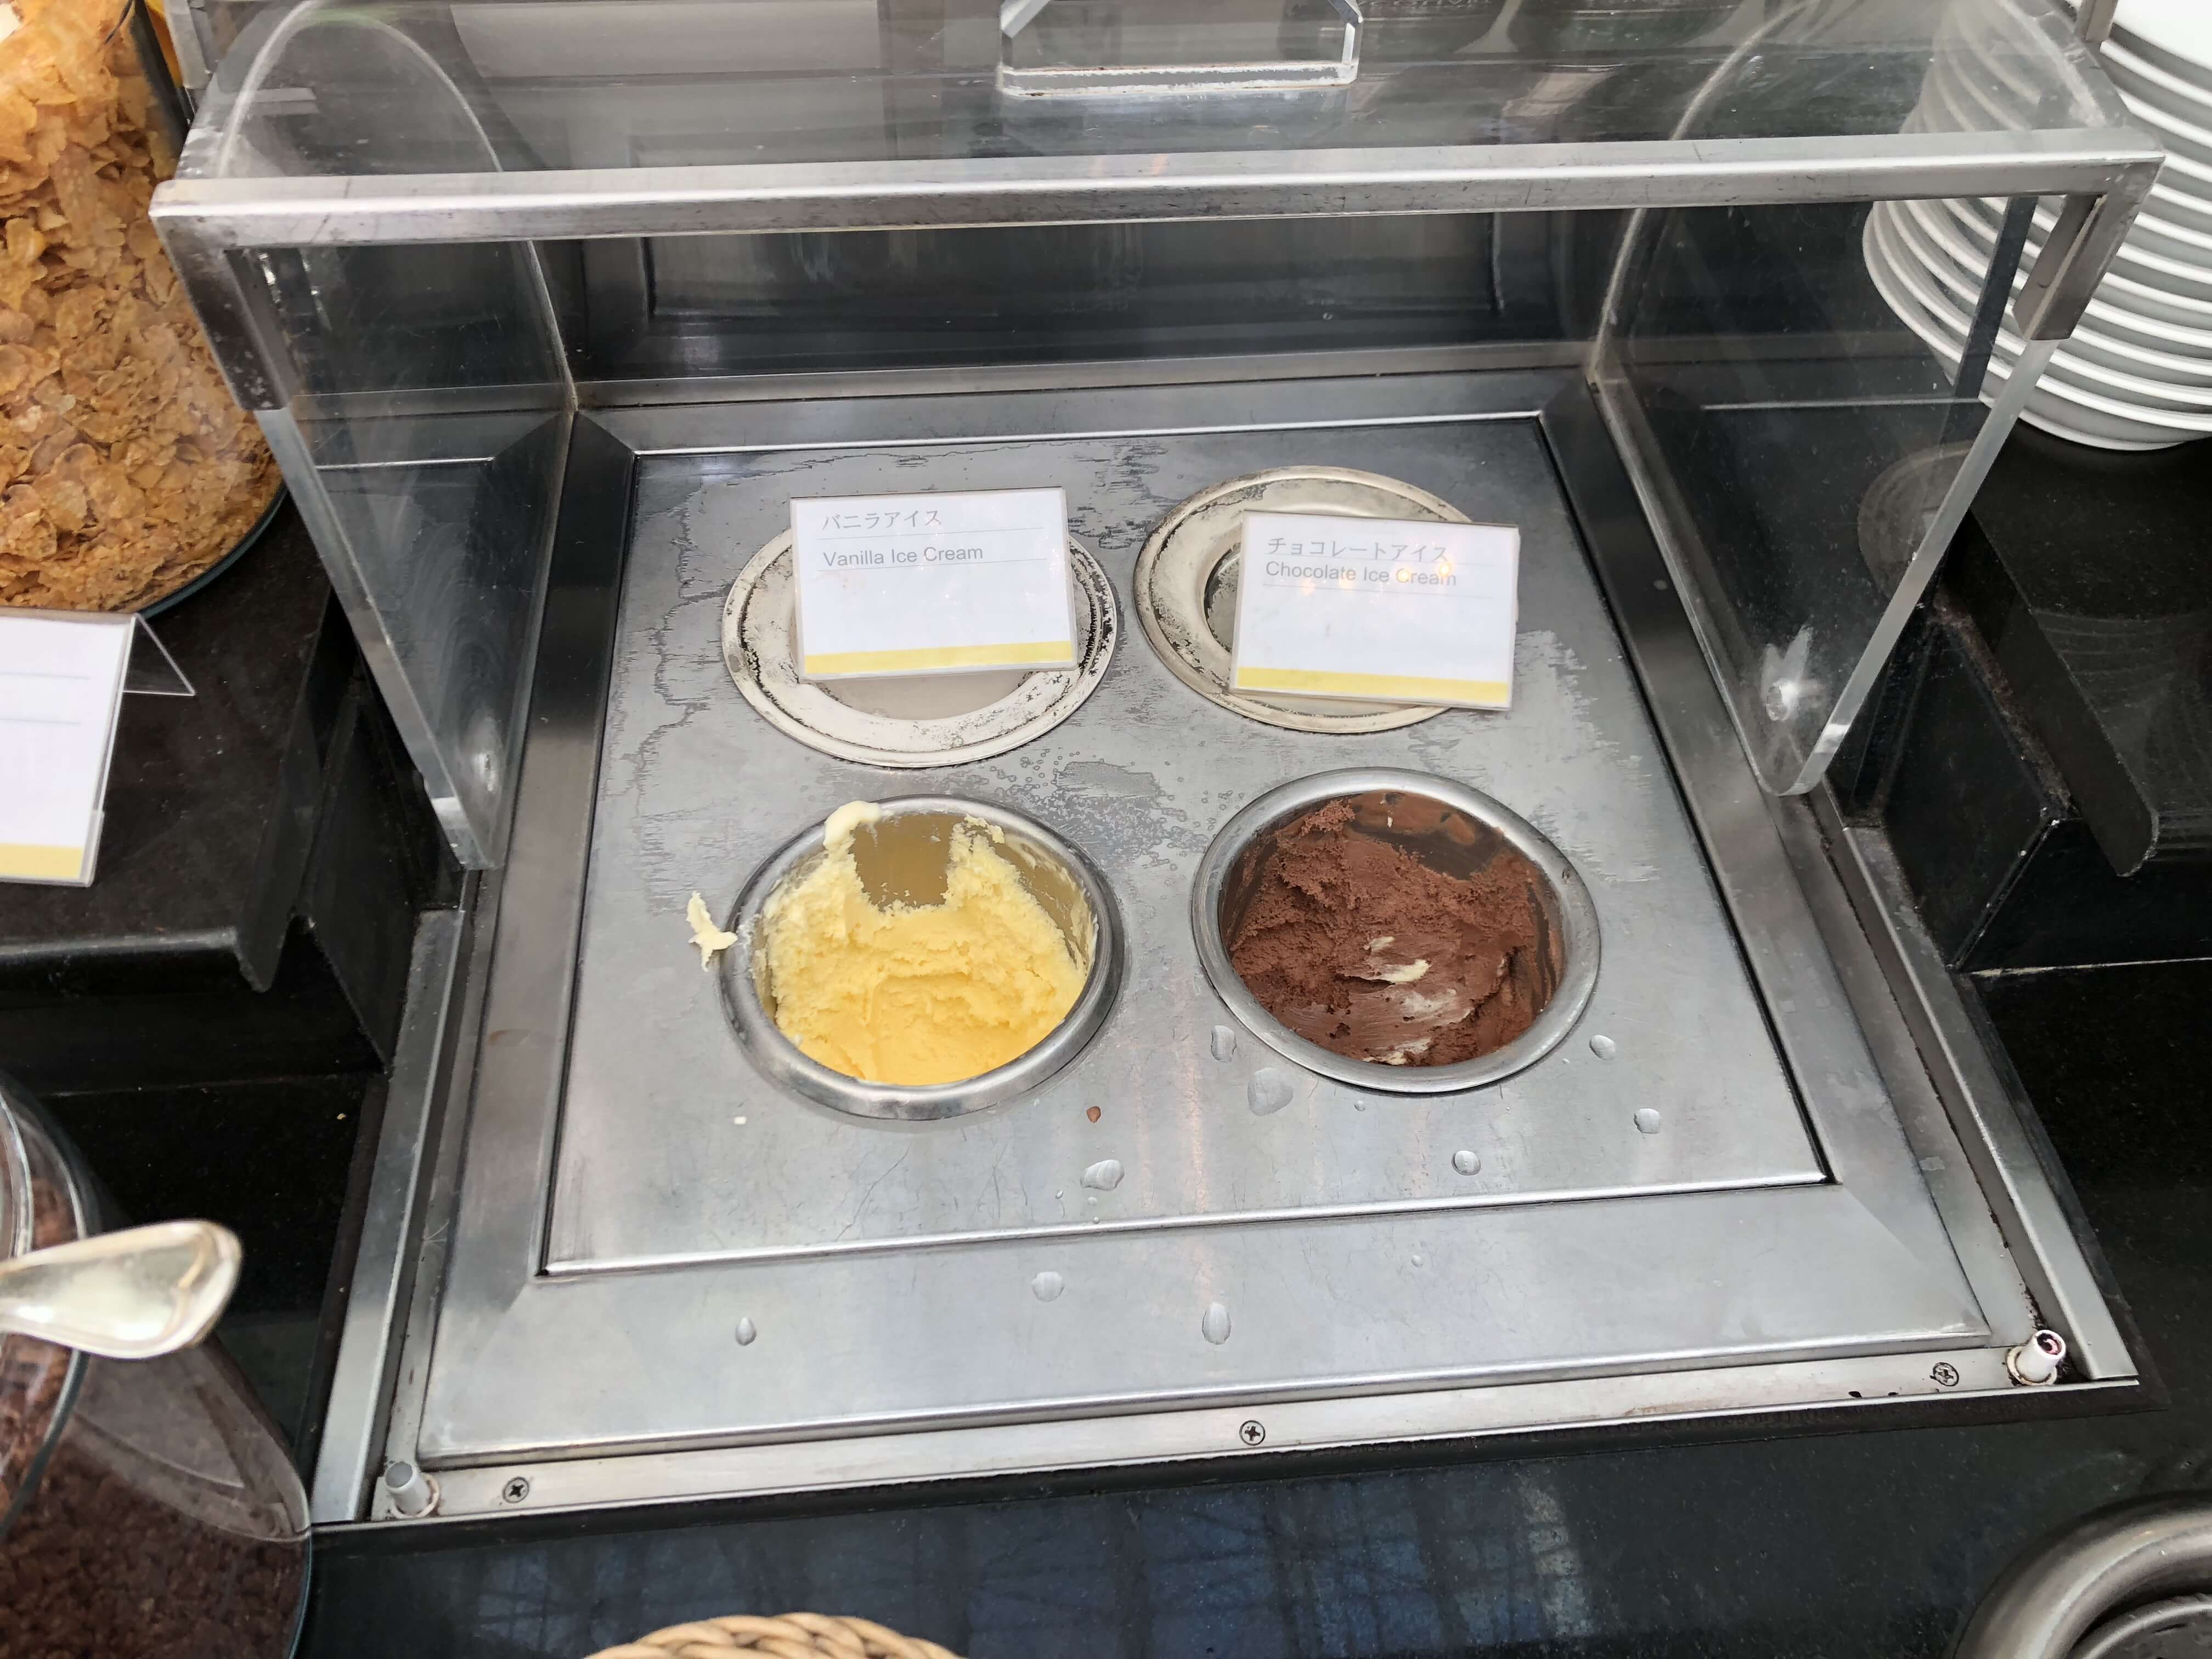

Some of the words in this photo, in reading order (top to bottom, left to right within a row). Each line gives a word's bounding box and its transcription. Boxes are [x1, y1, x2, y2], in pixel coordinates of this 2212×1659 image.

[822, 509, 942, 531] バニラアイス
[823, 550, 884, 566] Vanilla
[891, 549, 917, 563] Ice
[924, 546, 983, 562] Cream
[1268, 538, 1448, 562] チョコレートアイス
[1266, 561, 1357, 581] Chocolate
[1364, 567, 1390, 582] Ice
[1396, 569, 1457, 586] Cream
